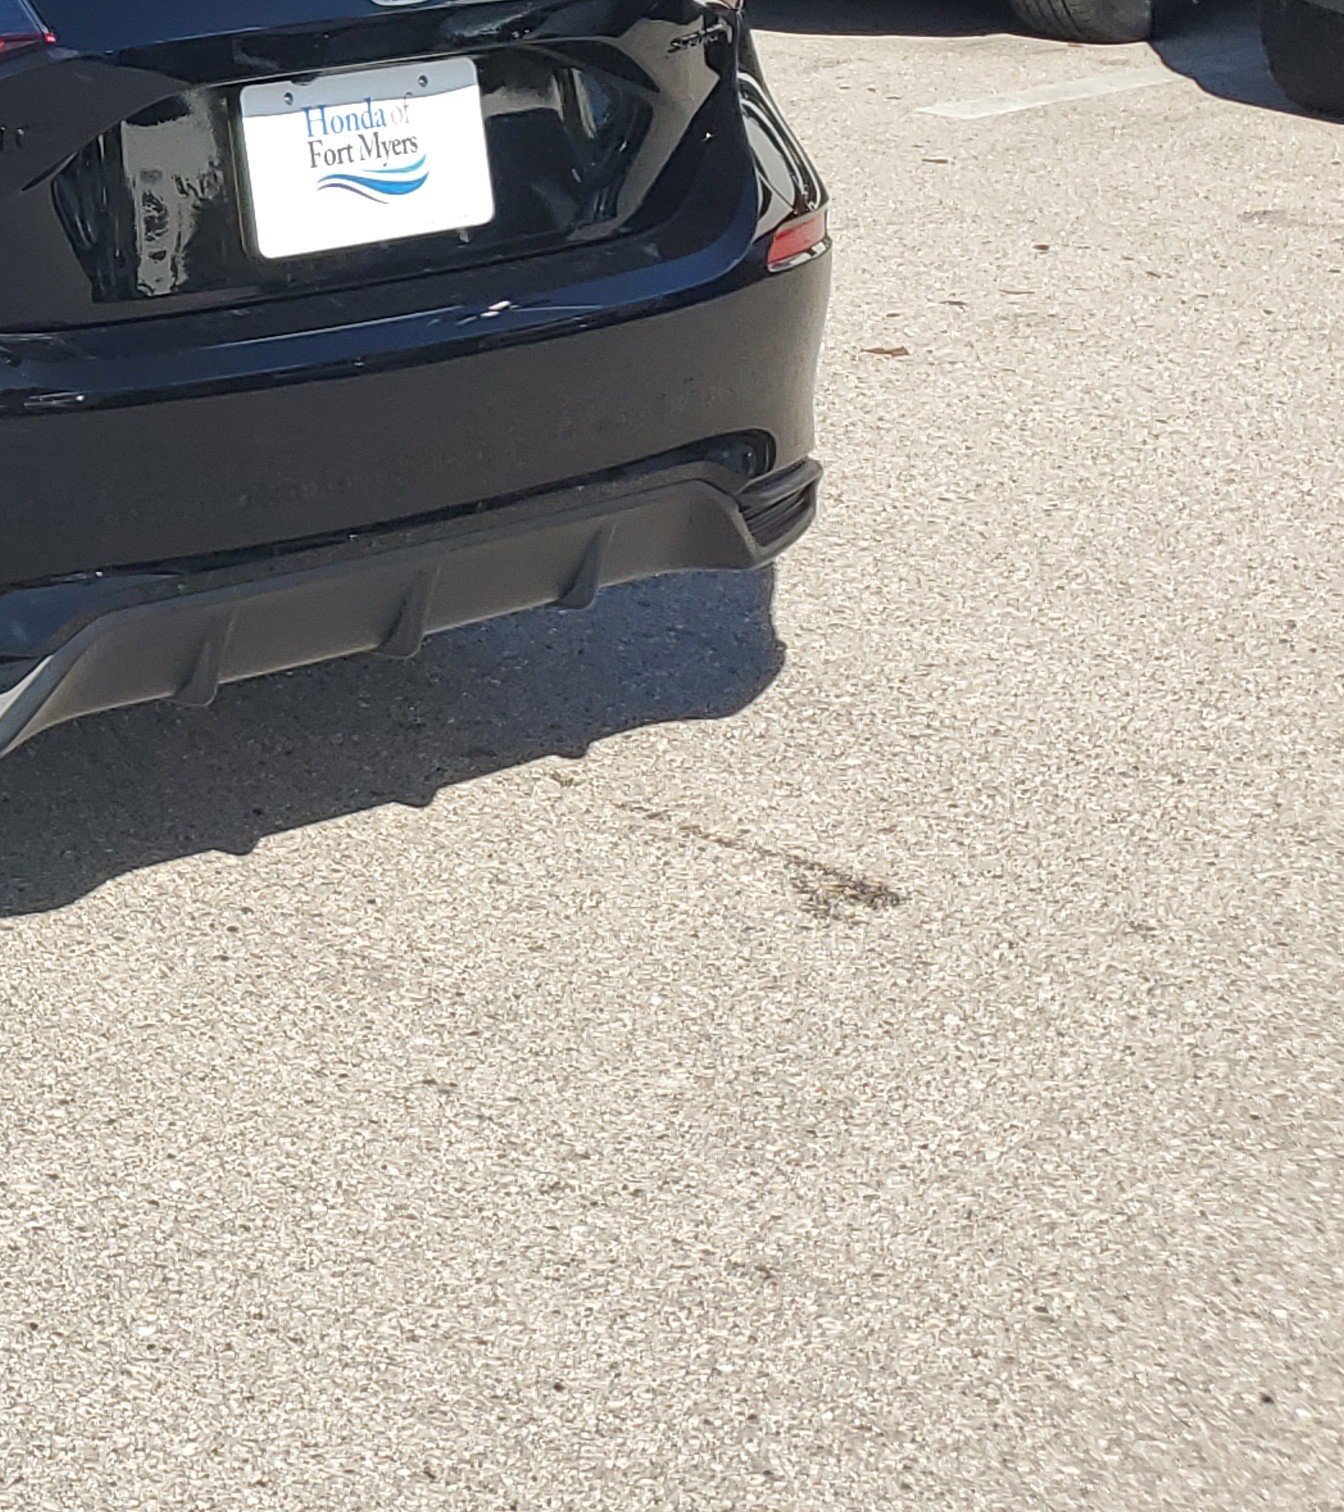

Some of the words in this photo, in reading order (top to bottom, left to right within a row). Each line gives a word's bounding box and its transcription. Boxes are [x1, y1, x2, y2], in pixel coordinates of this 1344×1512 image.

[302, 97, 387, 137] Honda
[390, 91, 413, 128] of
[308, 139, 355, 169] Fort
[357, 131, 419, 167] Myers
